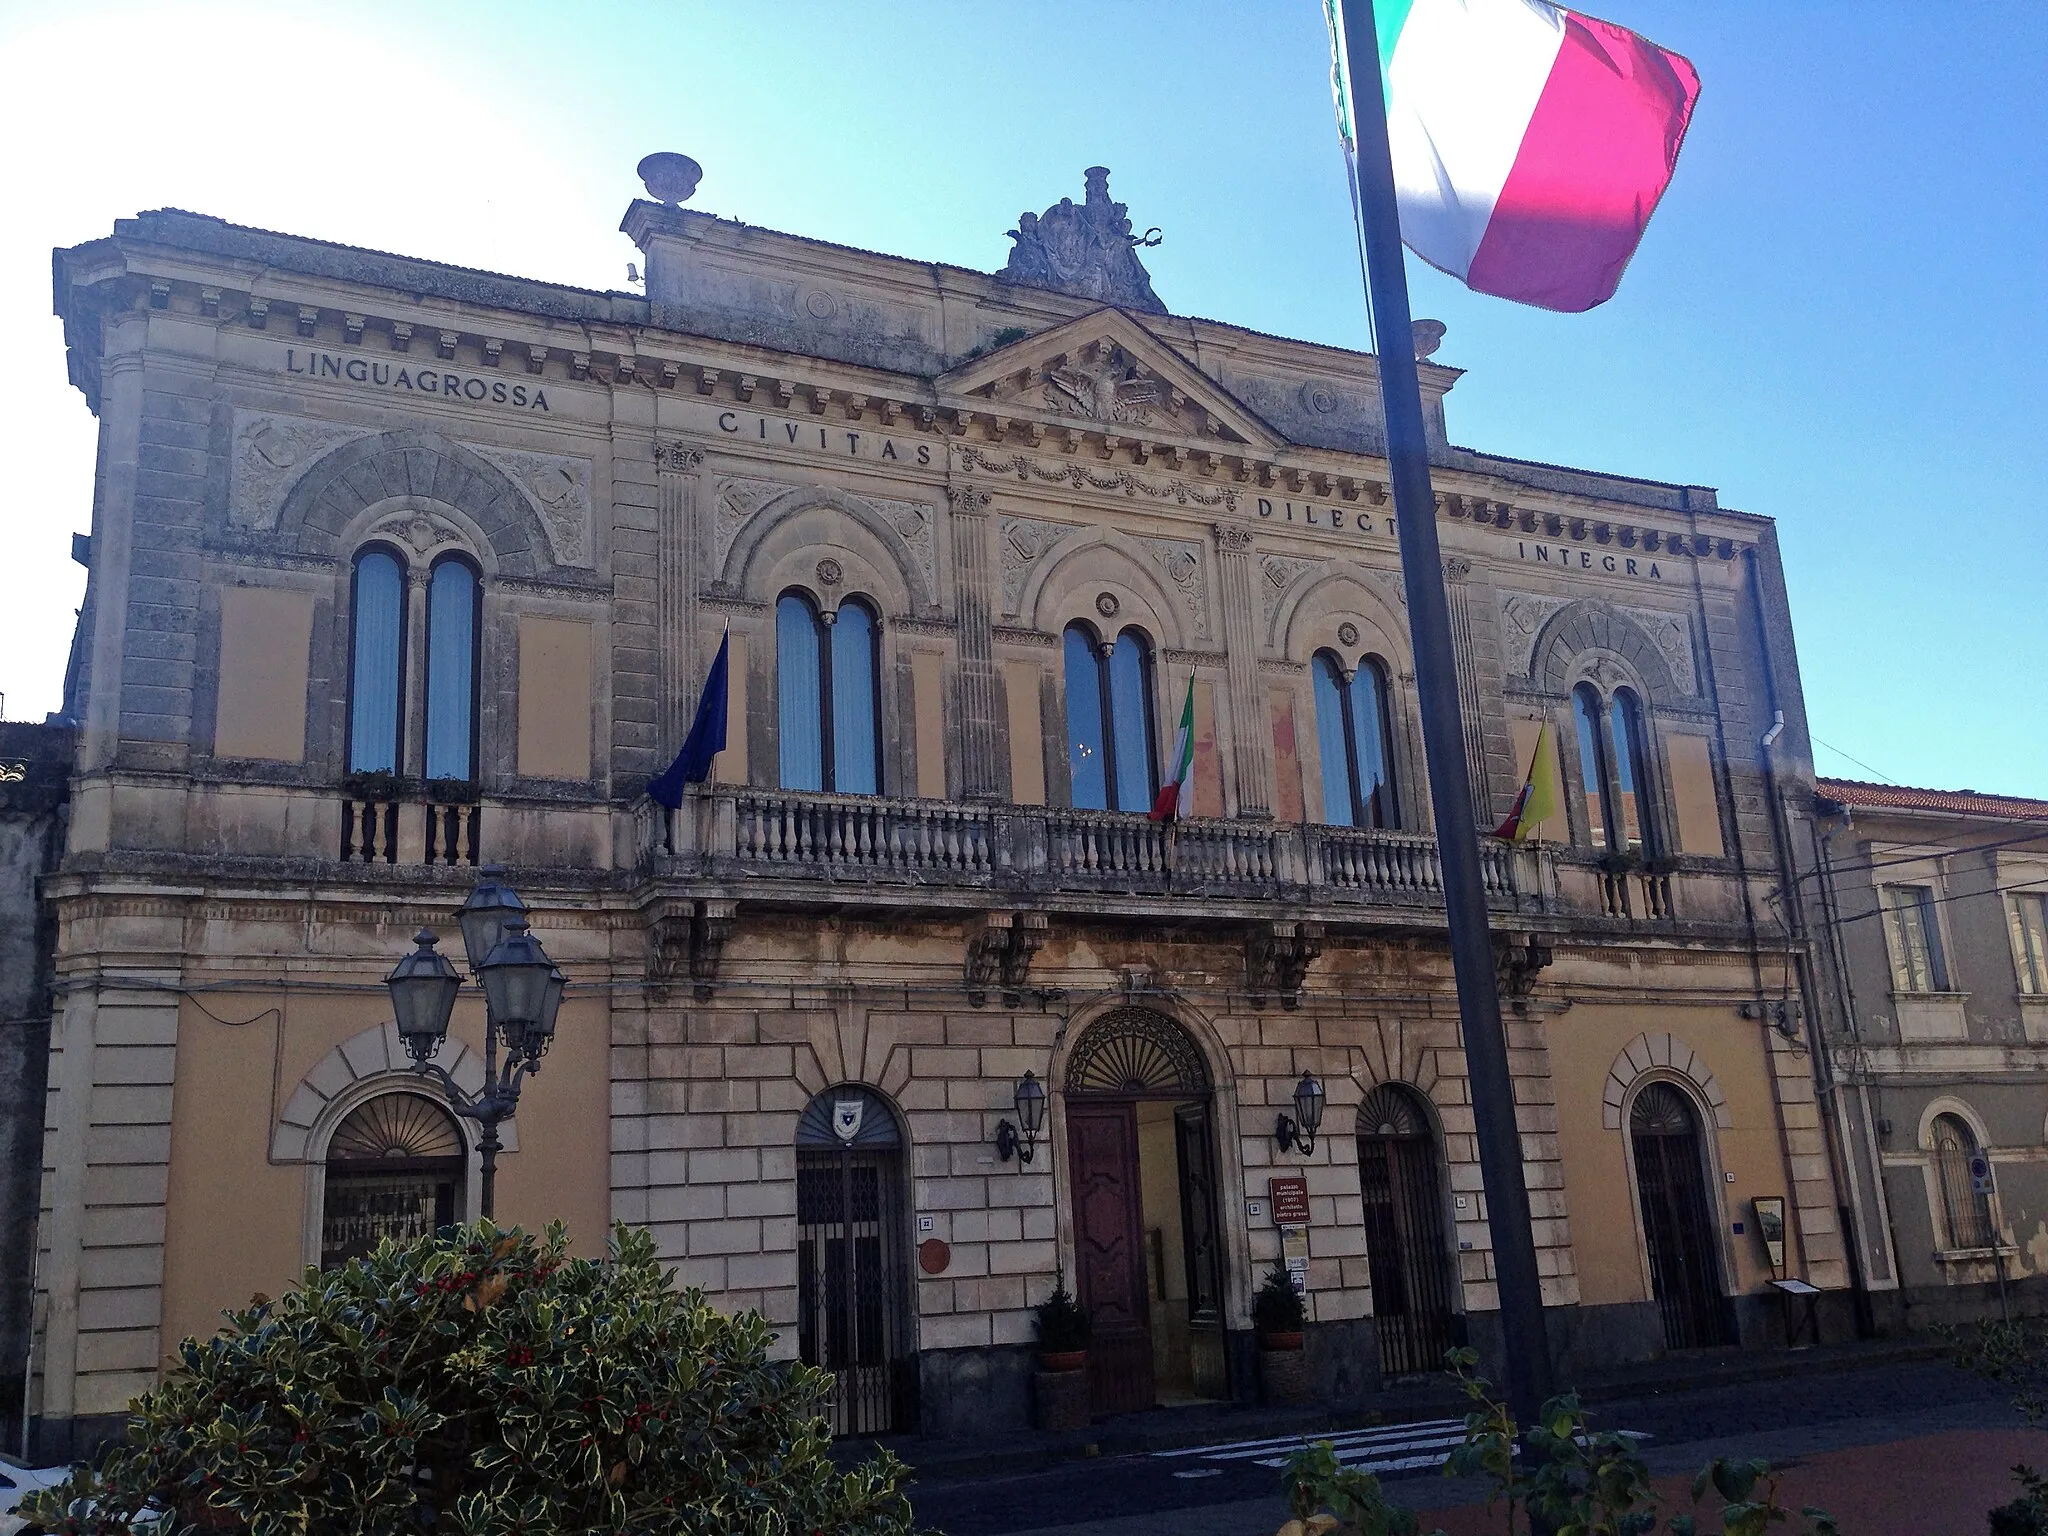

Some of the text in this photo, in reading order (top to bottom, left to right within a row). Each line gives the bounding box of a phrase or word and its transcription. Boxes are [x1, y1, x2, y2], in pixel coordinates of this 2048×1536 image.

[286, 349, 550, 412] LINGUAGROSSA
[718, 411, 931, 465] CIVITAS
[1258, 498, 1396, 536] DILECT
[1518, 541, 1662, 579] INTEGRA
